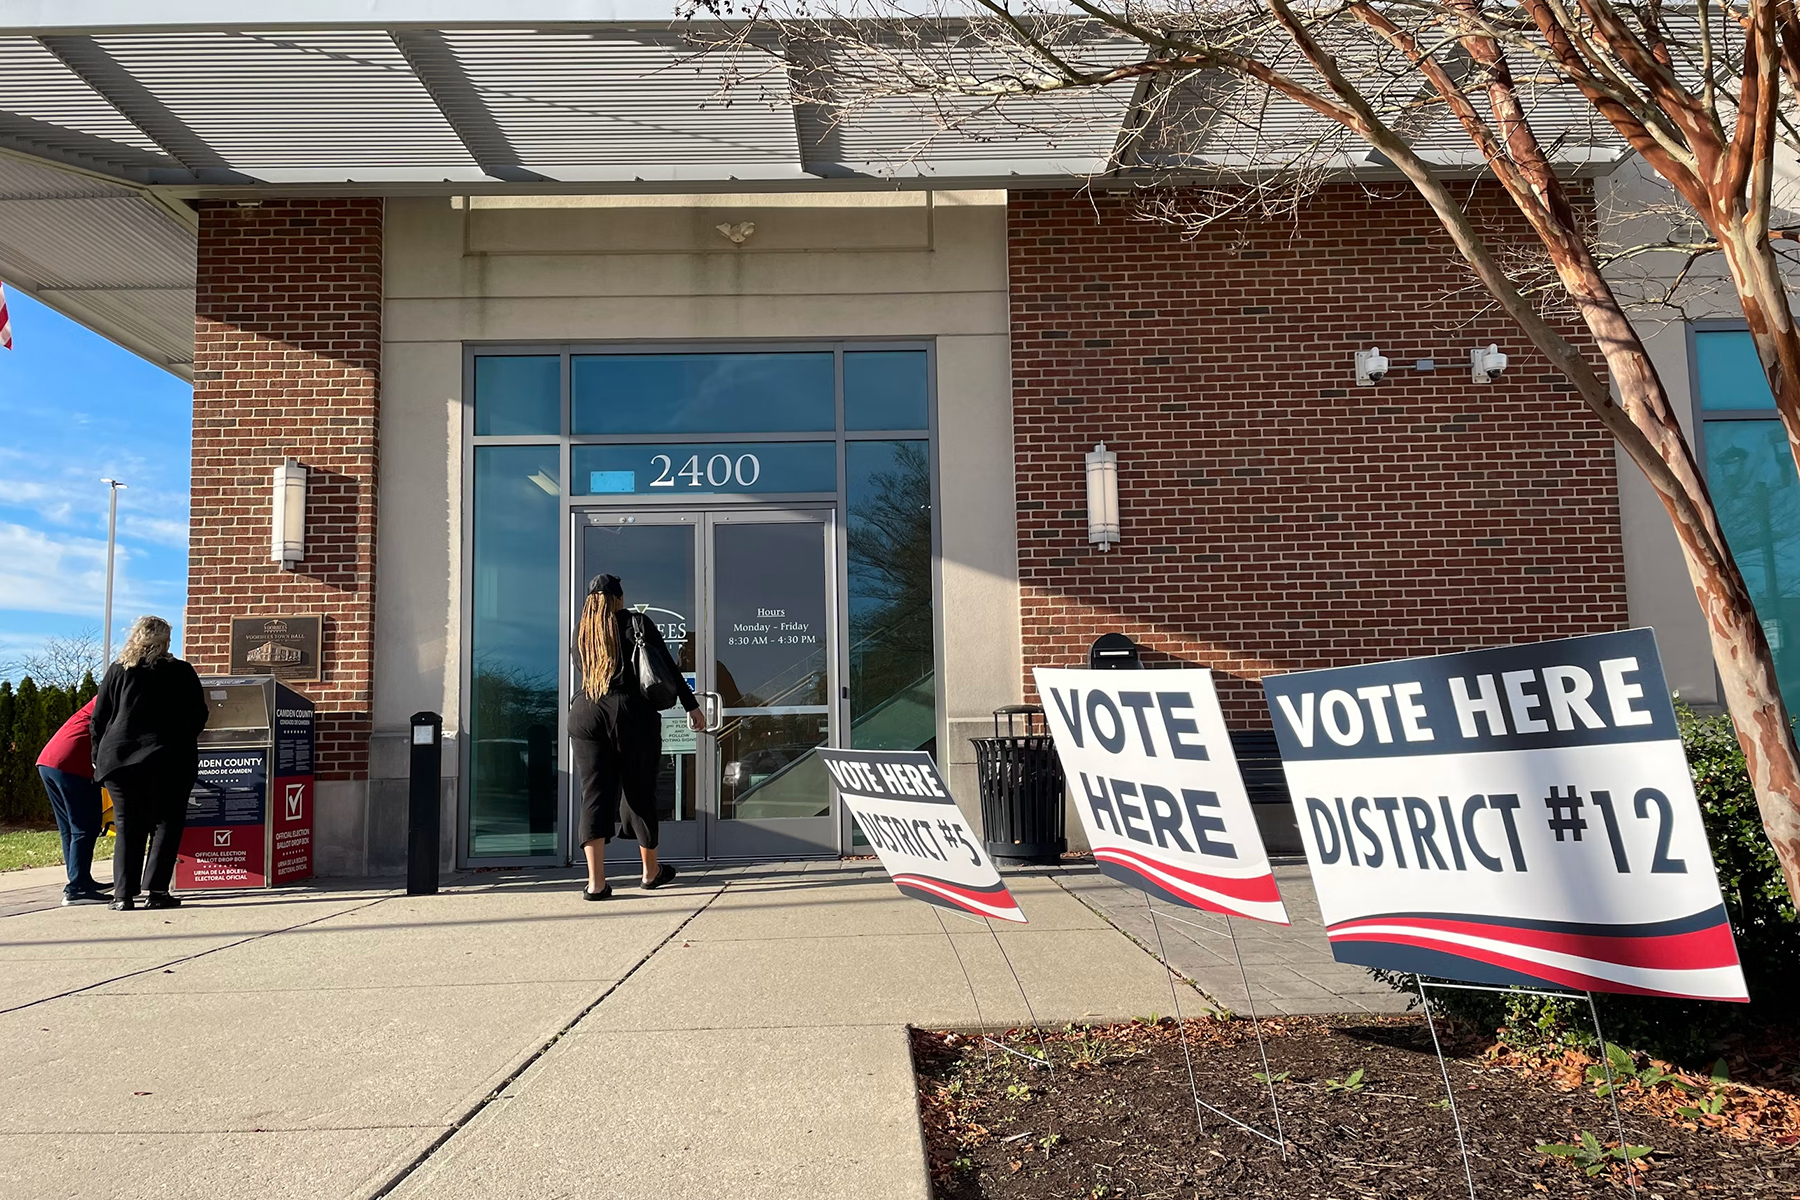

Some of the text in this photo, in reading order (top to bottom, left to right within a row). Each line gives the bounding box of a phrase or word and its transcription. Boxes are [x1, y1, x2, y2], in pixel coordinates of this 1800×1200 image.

[649, 453, 760, 487] 2400
[757, 608, 785, 617] Hours
[733, 622, 771, 633] Monday
[780, 622, 809, 632] Friday
[728, 636, 750, 645] 8:30
[751, 636, 768, 645] AM
[777, 635, 799, 644] 4:30
[801, 635, 816, 643] PM
[276, 708, 314, 718] CAMDEN COUNTY
[1275, 656, 1653, 748] VOTE HERE
[1049, 686, 1211, 762] VOTE
[223, 758, 263, 767] COUNTY
[824, 758, 946, 798] VOTE HERE
[1079, 771, 1239, 860] HERE
[276, 828, 310, 840] OFFICIAL ELECTION
[856, 810, 982, 867] DISTRICT #5
[1304, 784, 1689, 874] DISTRICT #12
[276, 837, 310, 850] BALLOT DROP BOX
